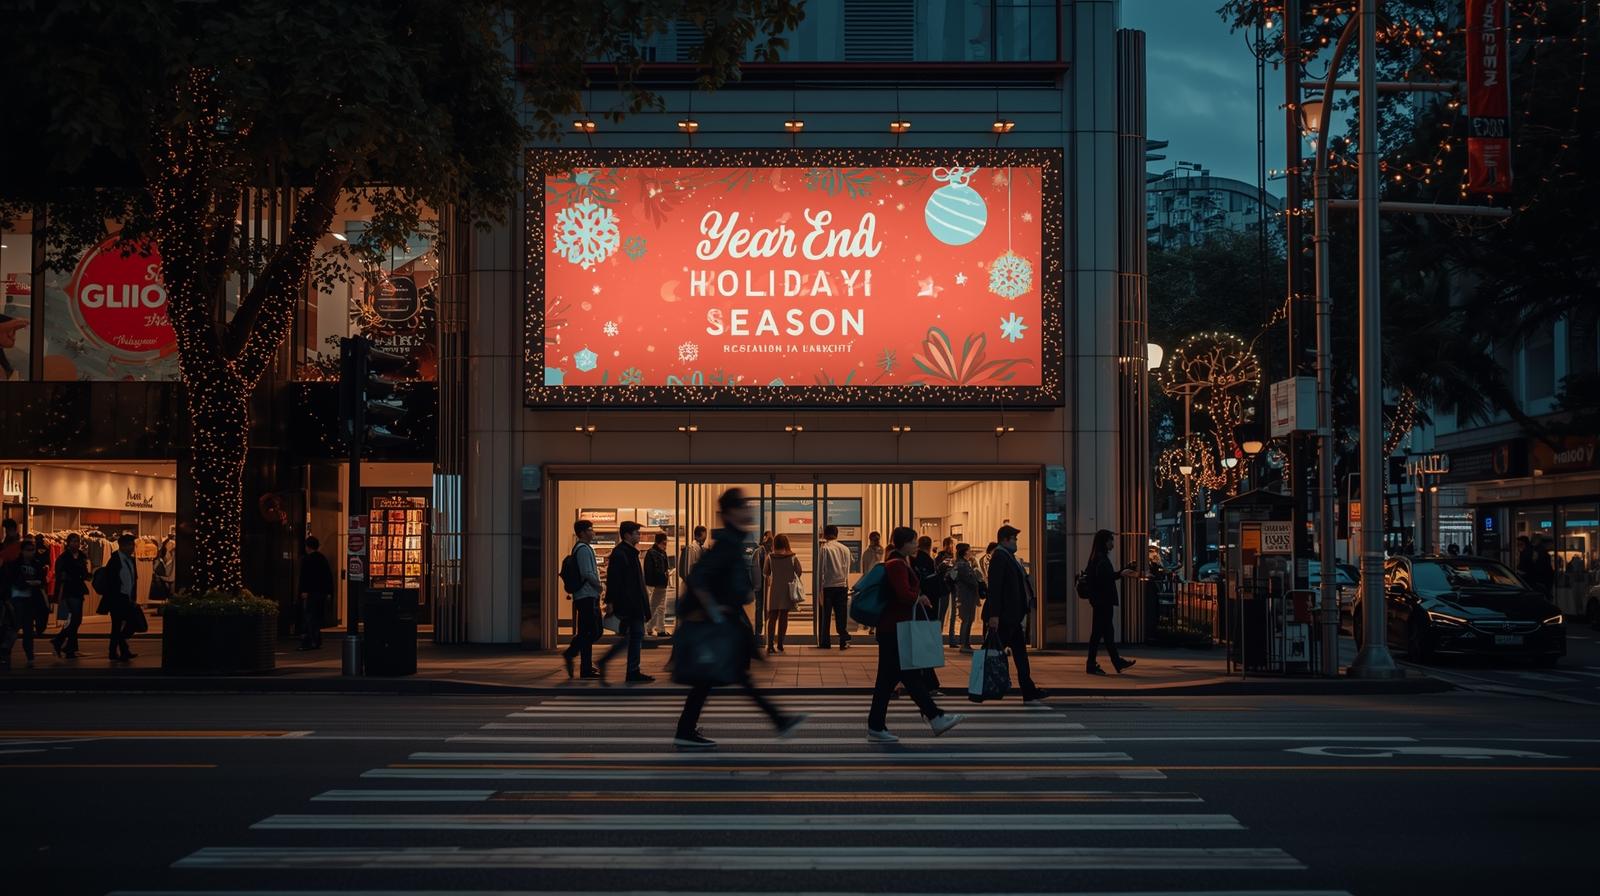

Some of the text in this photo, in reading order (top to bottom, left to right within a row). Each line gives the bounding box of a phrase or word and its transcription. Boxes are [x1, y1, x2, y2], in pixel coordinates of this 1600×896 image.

[695, 208, 883, 261] Year End
[706, 308, 865, 337] SEASON
